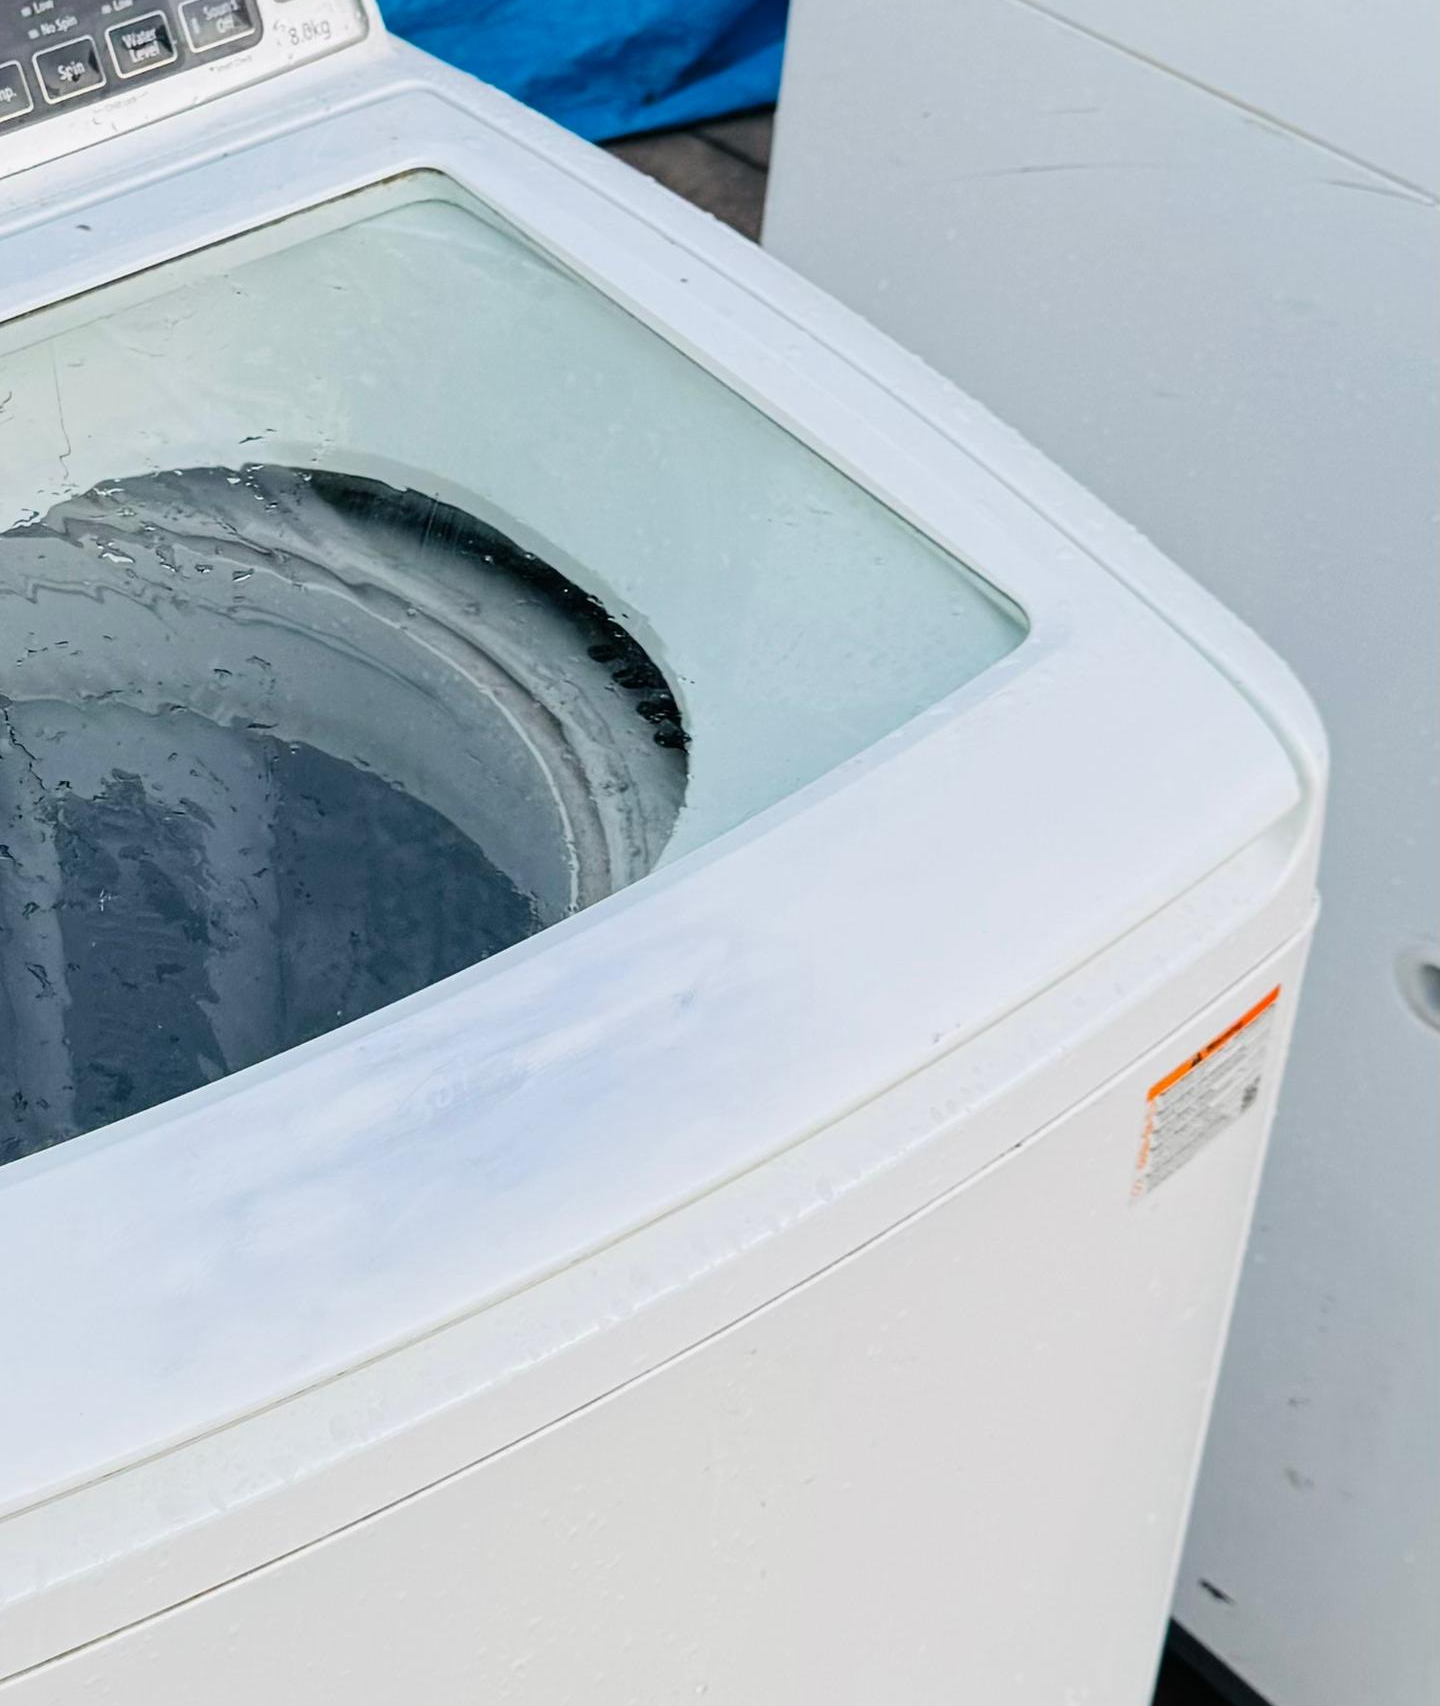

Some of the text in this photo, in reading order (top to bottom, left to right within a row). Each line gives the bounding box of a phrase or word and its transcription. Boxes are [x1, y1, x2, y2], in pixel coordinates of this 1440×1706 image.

[33, 0, 54, 14] Low
[40, 15, 78, 36] No Spin
[121, 27, 157, 49] Water
[128, 40, 160, 63] Level
[57, 60, 86, 81] Spin
